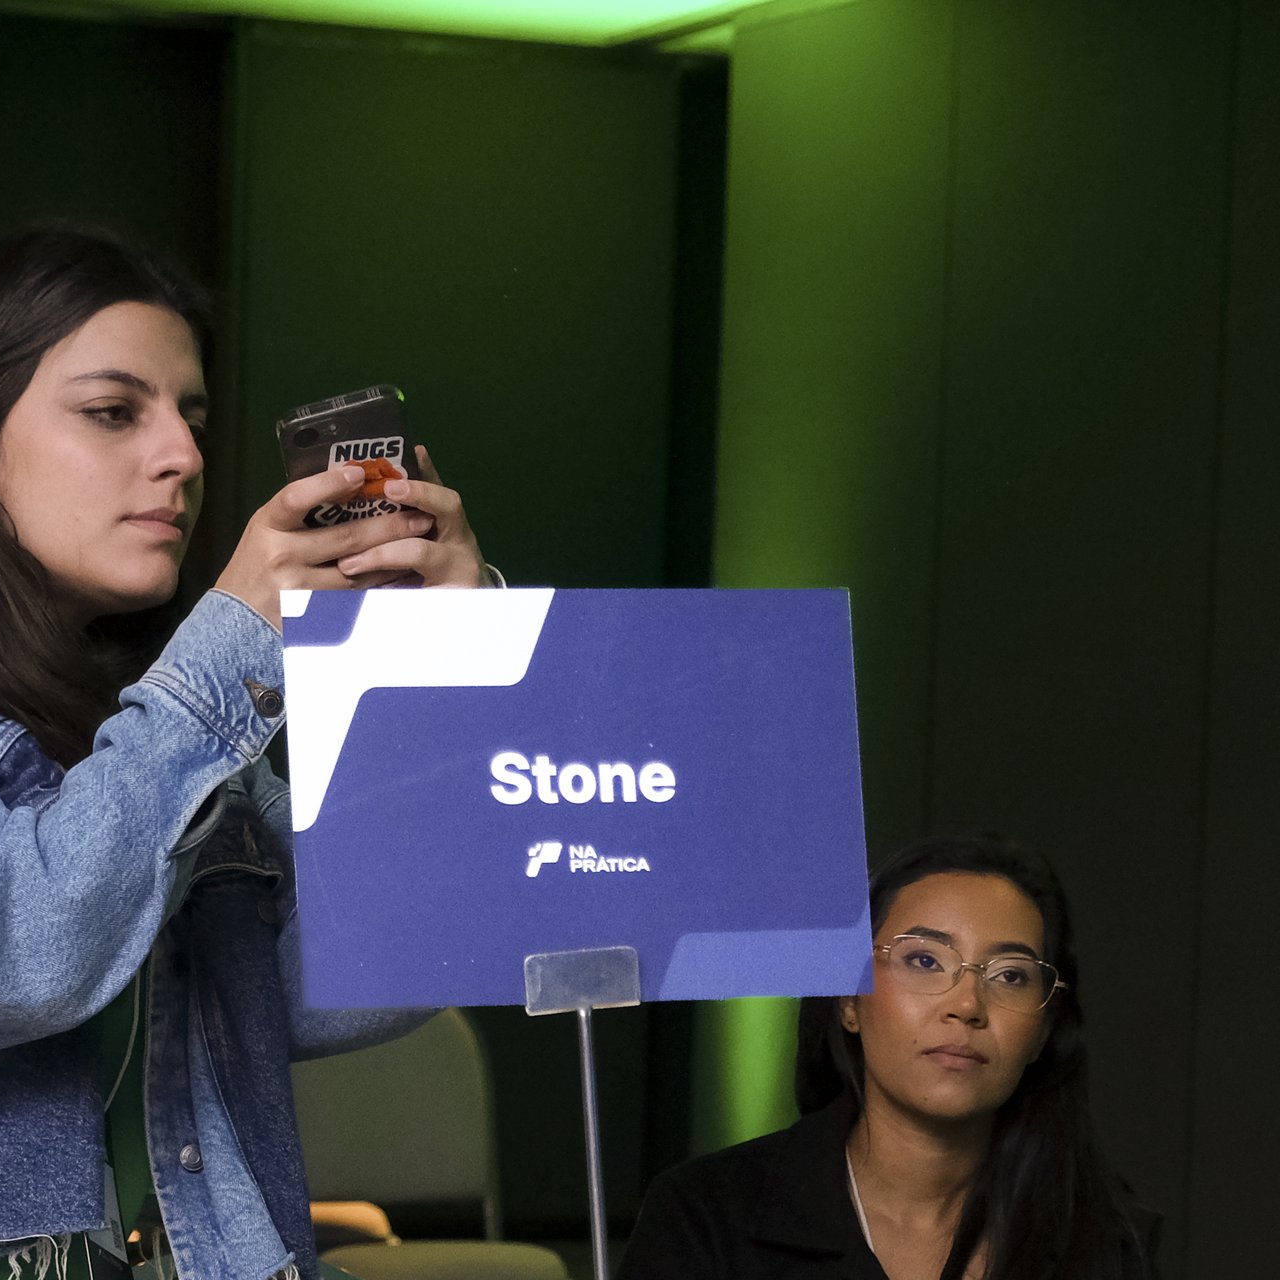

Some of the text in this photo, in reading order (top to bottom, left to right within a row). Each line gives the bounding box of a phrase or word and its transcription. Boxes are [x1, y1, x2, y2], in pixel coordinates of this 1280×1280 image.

[335, 440, 401, 462] NUGS
[490, 751, 676, 805] Stone
[569, 845, 597, 859] NA
